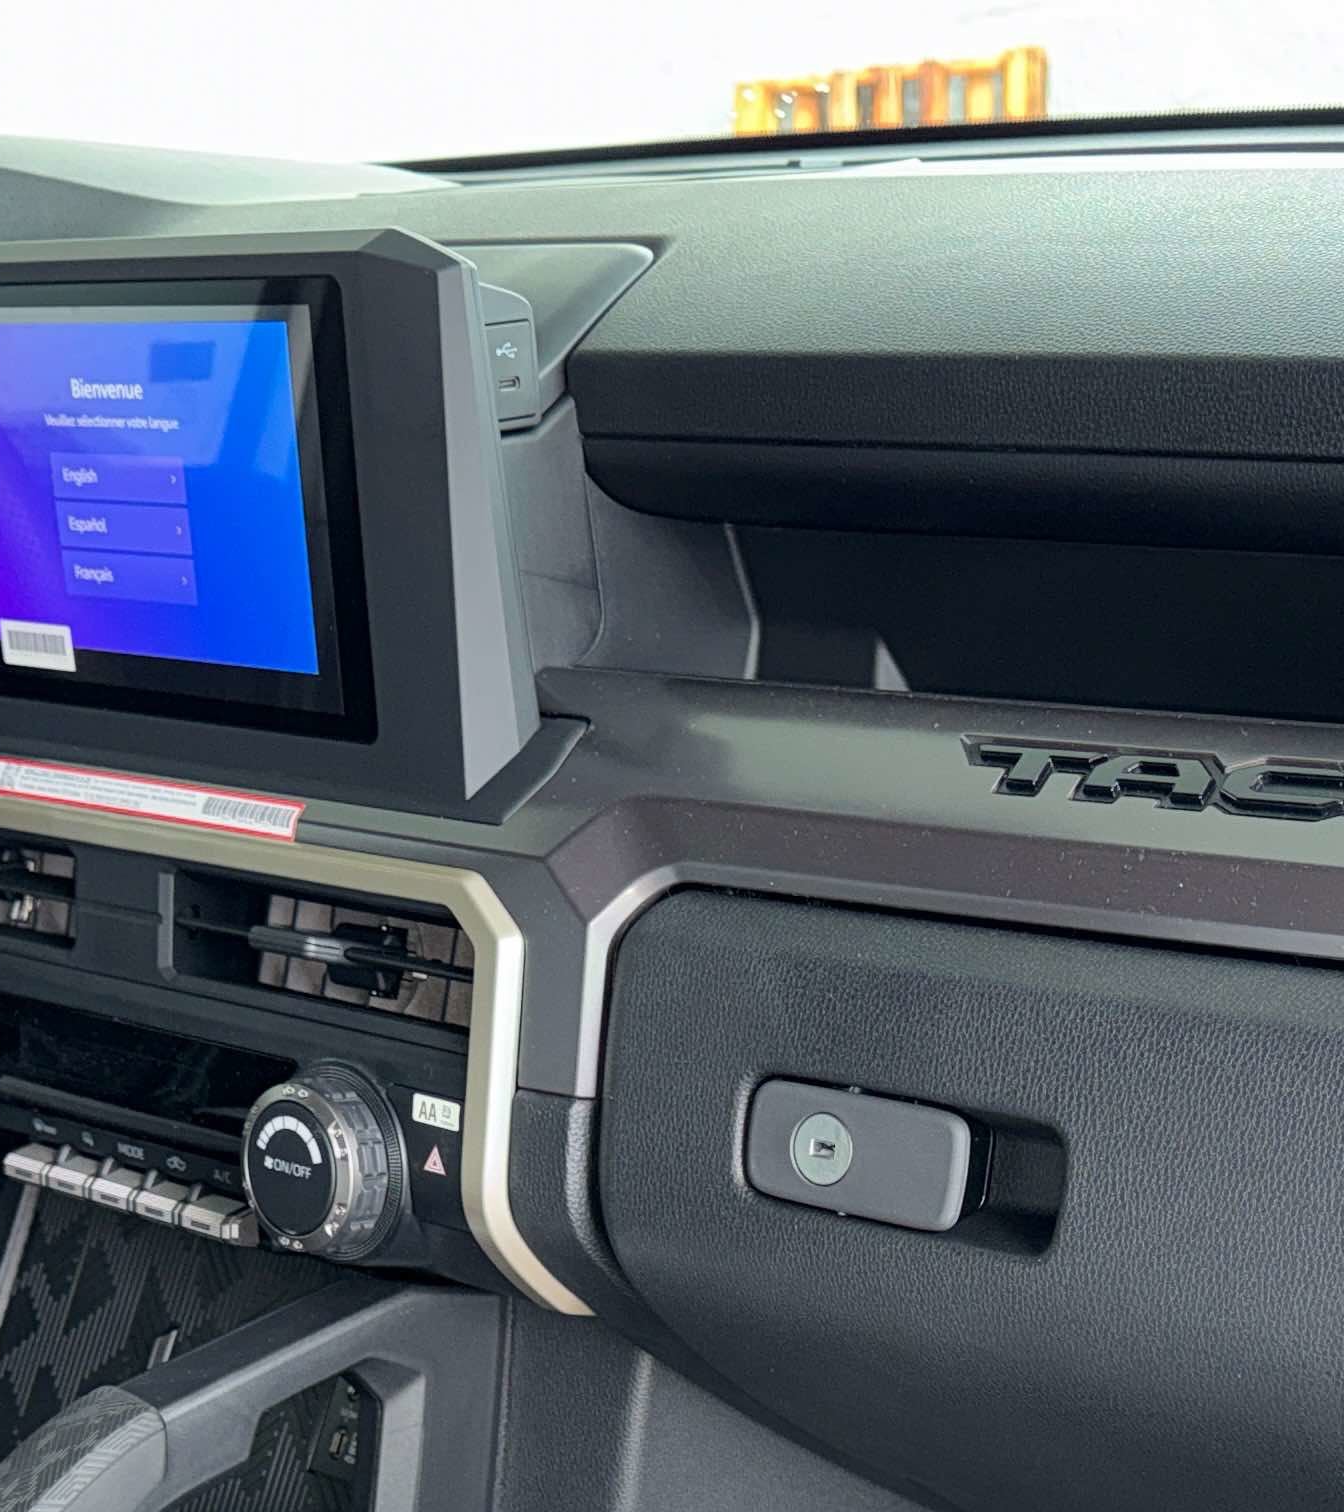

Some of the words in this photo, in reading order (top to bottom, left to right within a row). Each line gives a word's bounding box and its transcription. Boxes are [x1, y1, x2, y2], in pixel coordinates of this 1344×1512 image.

[70, 377, 144, 400] Bienvenue
[62, 466, 98, 487] English
[67, 515, 107, 534] Español
[74, 563, 114, 584] Français
[418, 1100, 437, 1123] AA
[117, 1142, 145, 1161] MODE
[273, 1157, 312, 1180] ON/OFF
